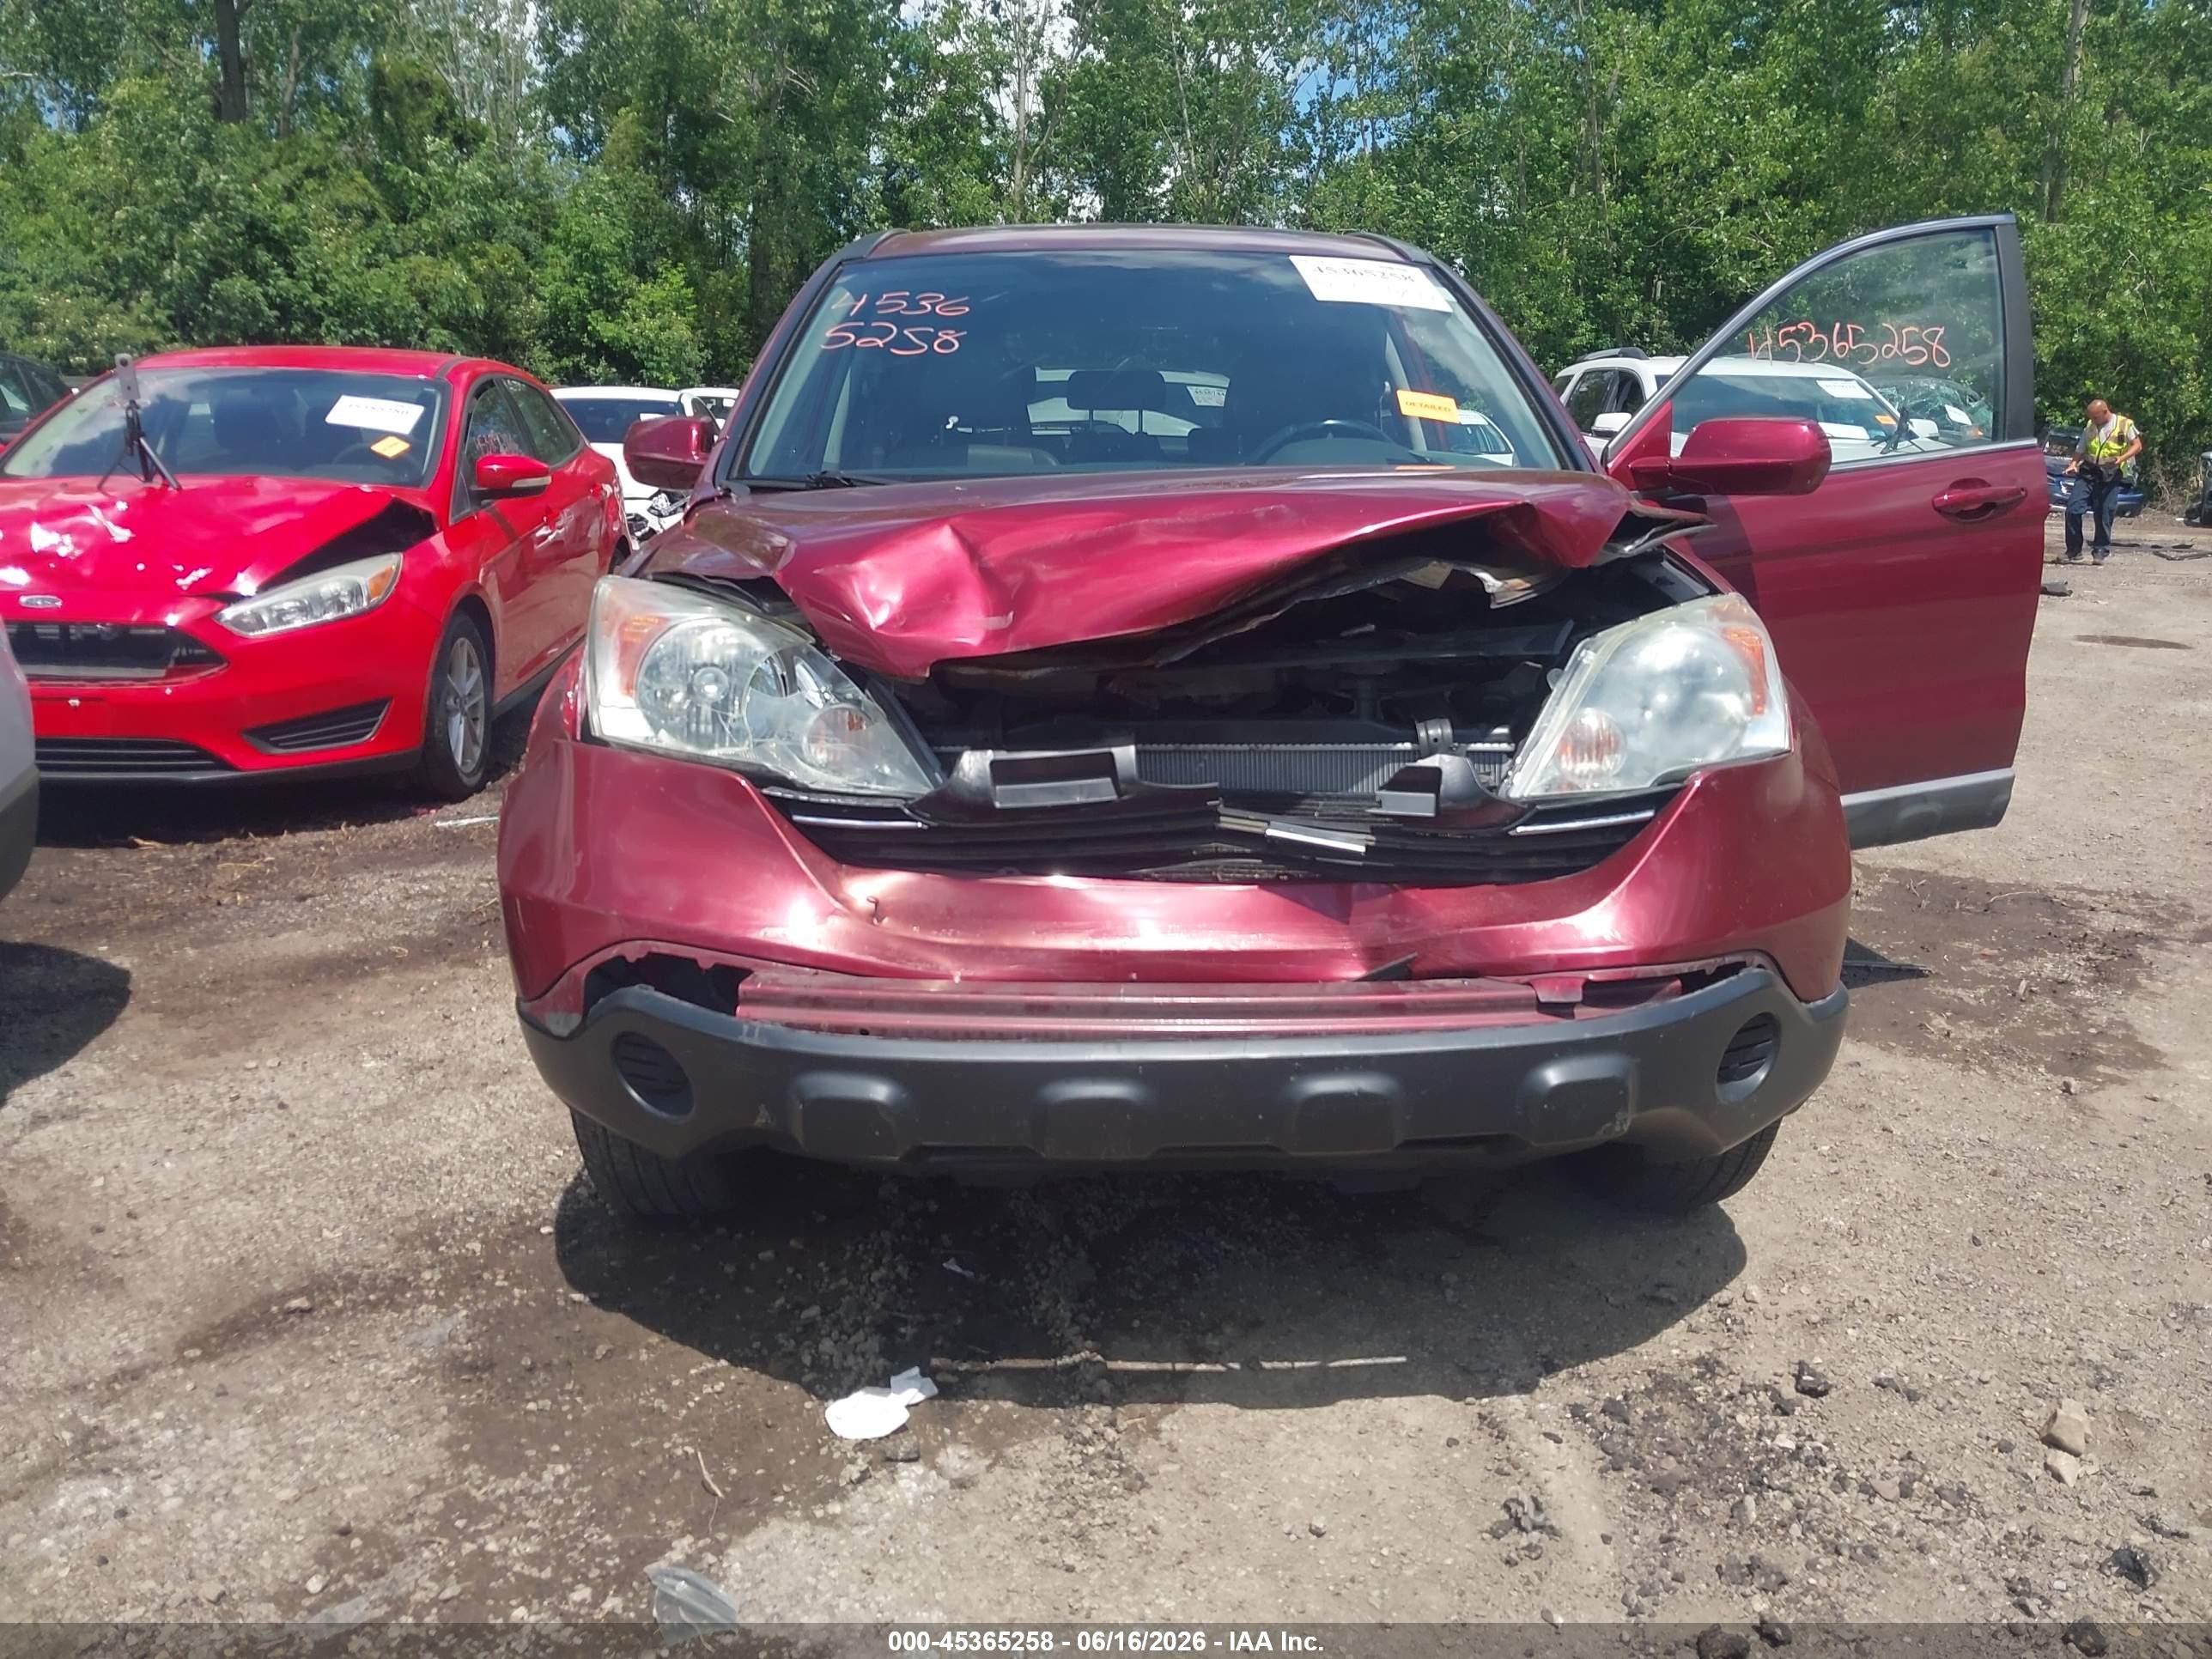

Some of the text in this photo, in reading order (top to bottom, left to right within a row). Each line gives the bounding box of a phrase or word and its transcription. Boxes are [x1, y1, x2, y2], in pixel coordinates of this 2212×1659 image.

[830, 290, 971, 317] 4536
[819, 320, 969, 356] 5258
[1748, 321, 1951, 368] 45365258
